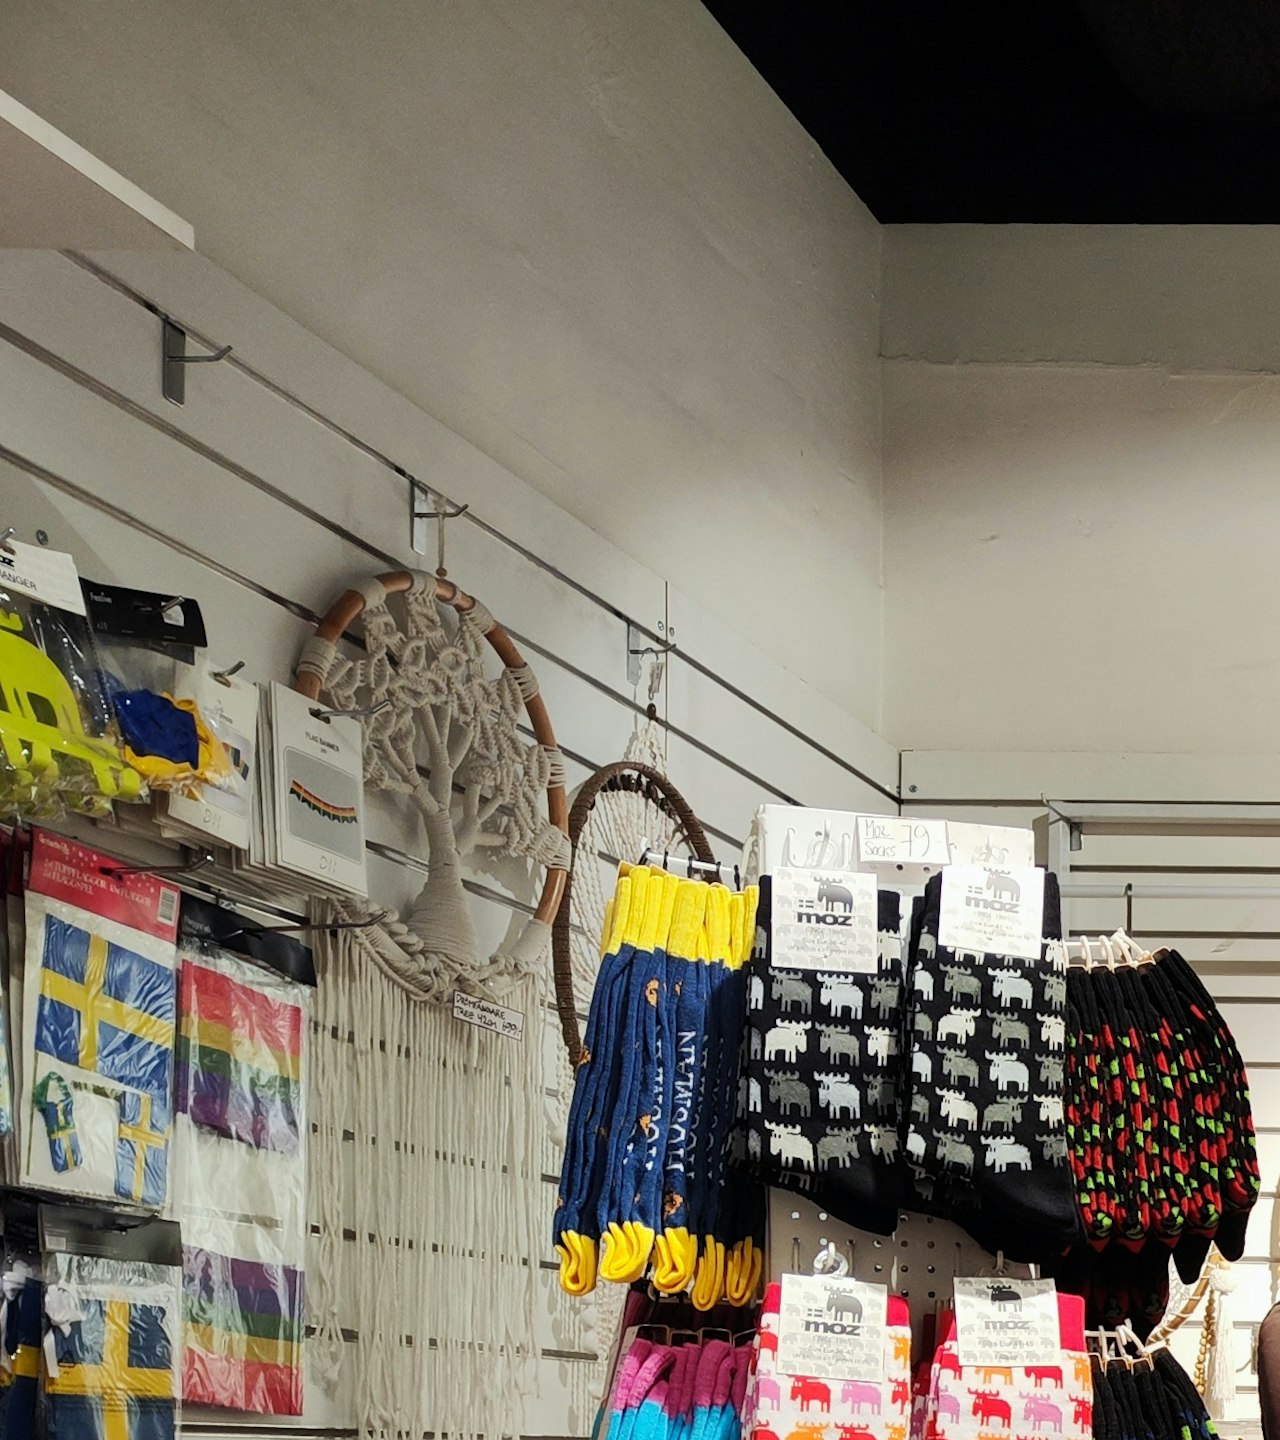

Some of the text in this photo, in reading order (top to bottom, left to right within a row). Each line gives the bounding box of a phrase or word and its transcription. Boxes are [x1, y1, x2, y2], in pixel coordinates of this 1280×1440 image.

[965, 895, 1020, 914] moz
[797, 911, 853, 927] moz
[805, 1320, 861, 1337] moz
[984, 1320, 1032, 1331] moz
